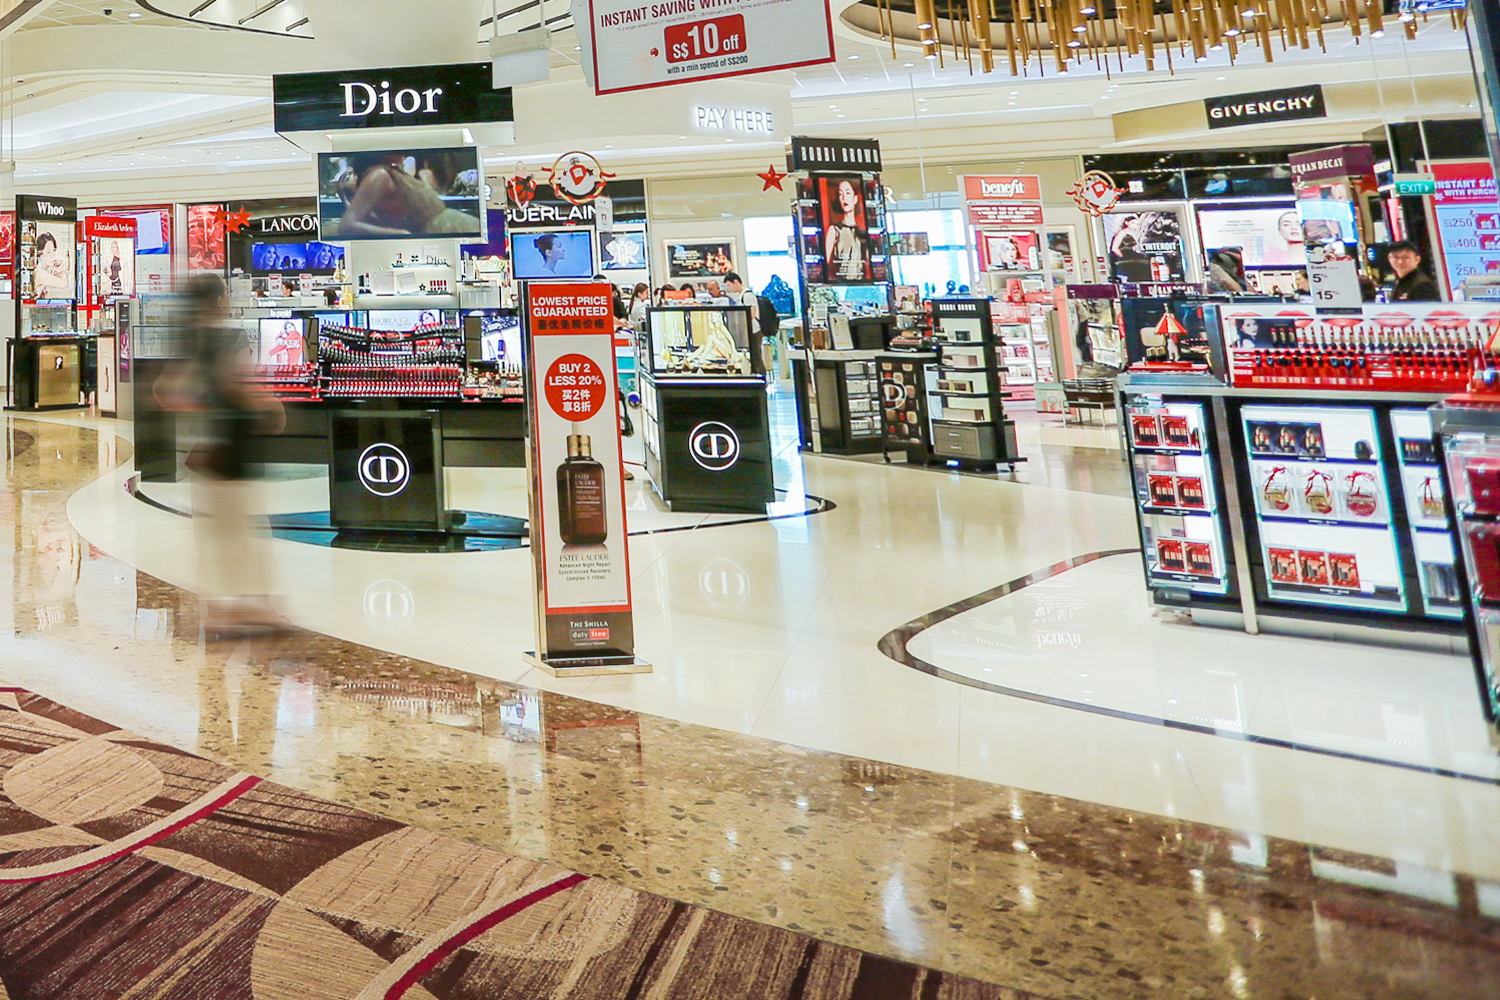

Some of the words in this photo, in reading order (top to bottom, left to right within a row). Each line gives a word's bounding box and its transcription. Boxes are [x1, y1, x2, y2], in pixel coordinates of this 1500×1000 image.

[601, 7, 647, 28] INSTANT
[723, 34, 739, 51] off
[667, 66, 680, 74] with
[700, 60, 719, 71] spend
[728, 55, 748, 66] S$200
[339, 80, 443, 118] Dior
[1209, 95, 1315, 120] GIVENCHY
[695, 106, 727, 129] PAY
[731, 109, 773, 132] HERE
[801, 146, 835, 162] BOBBI
[841, 148, 879, 163] BROWN
[1291, 161, 1318, 175] URBAN
[1318, 157, 1344, 169] DECAY
[980, 178, 1025, 197] benefit
[1400, 184, 1422, 193] EXIT
[37, 201, 65, 216] Whoo
[93, 221, 119, 231] Elizabeth
[119, 224, 134, 233] Arden
[426, 256, 448, 265] Dior
[532, 297, 574, 307] LOWEST
[577, 296, 608, 306] PRICE
[533, 307, 608, 317] GUARANTEED
[559, 363, 581, 373] BUY
[583, 363, 591, 373] 2
[549, 376, 576, 386] LESS
[578, 375, 602, 386] 20%
[562, 389, 591, 400] 买2件
[581, 553, 609, 561] LAUDER
[584, 620, 609, 628] SHILLA
[572, 631, 588, 640] duty
[591, 630, 607, 638] free
